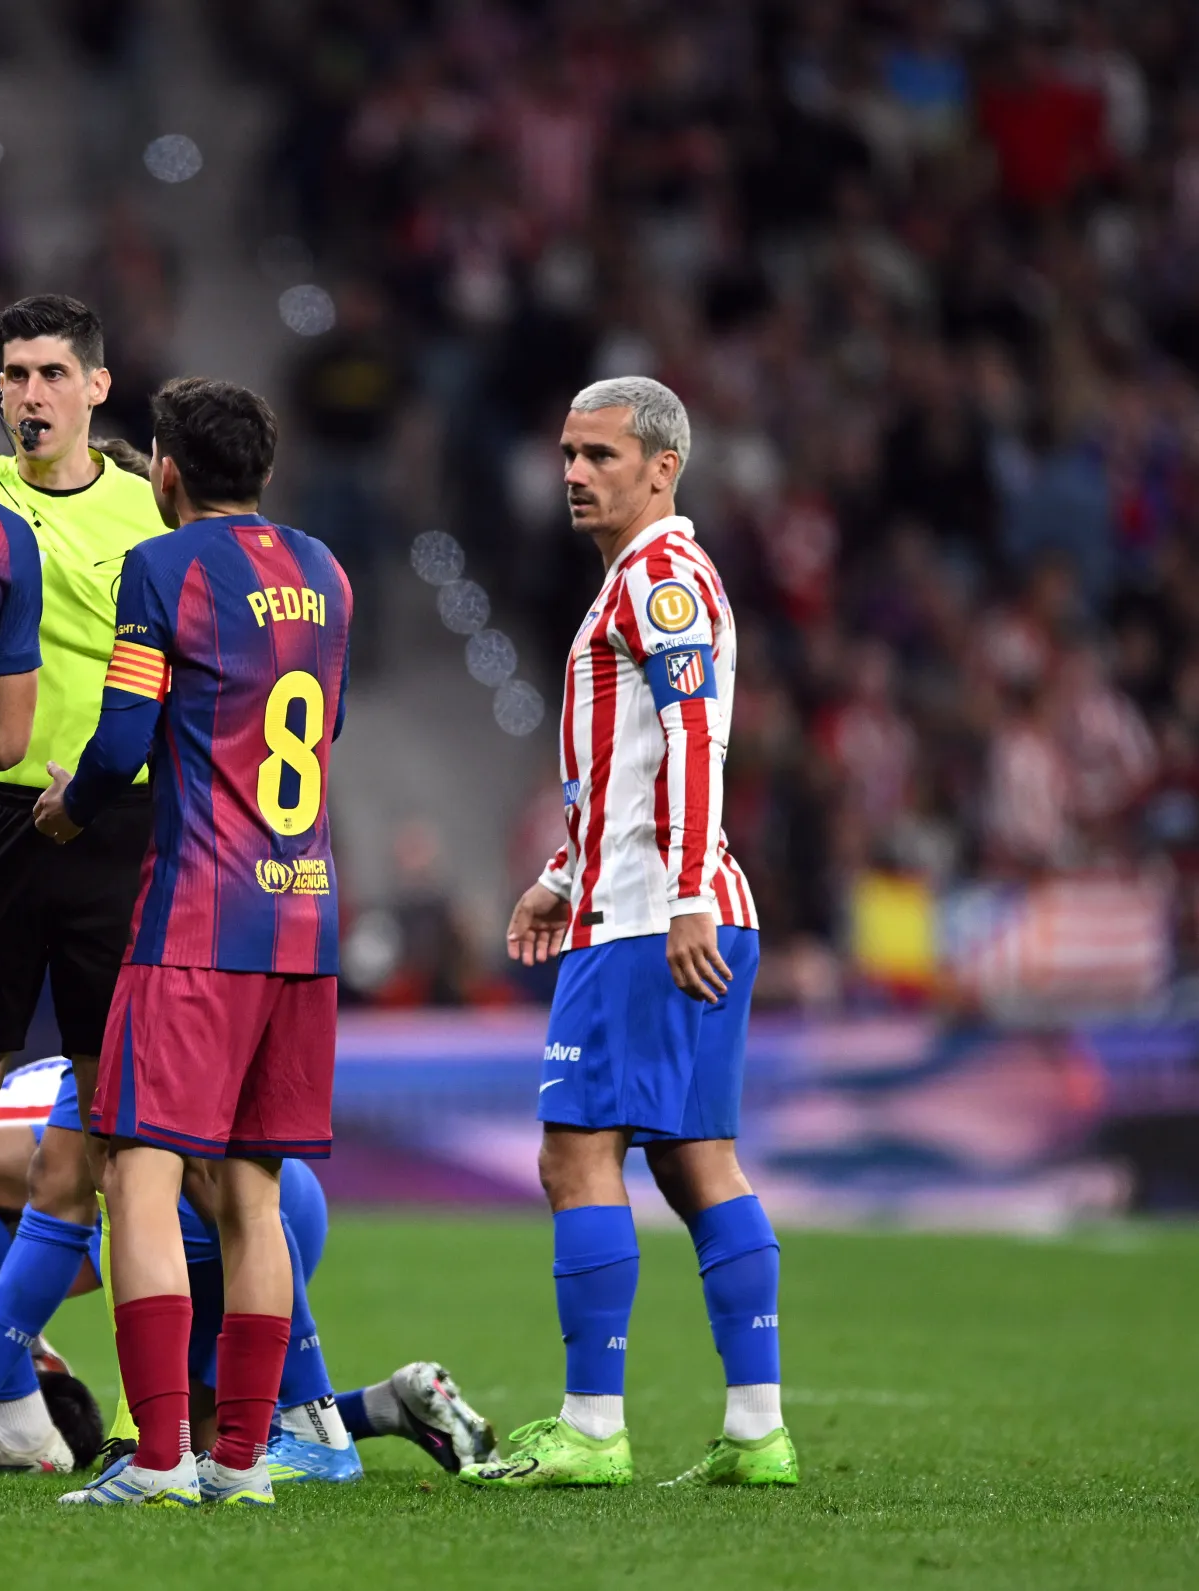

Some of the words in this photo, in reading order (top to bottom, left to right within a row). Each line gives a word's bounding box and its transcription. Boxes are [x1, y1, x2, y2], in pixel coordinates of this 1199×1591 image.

[246, 586, 325, 628] PEDRI
[137, 625, 147, 633] tv
[257, 670, 324, 836] 8
[292, 860, 327, 874] UNHCR
[292, 874, 329, 889] ACNUR
